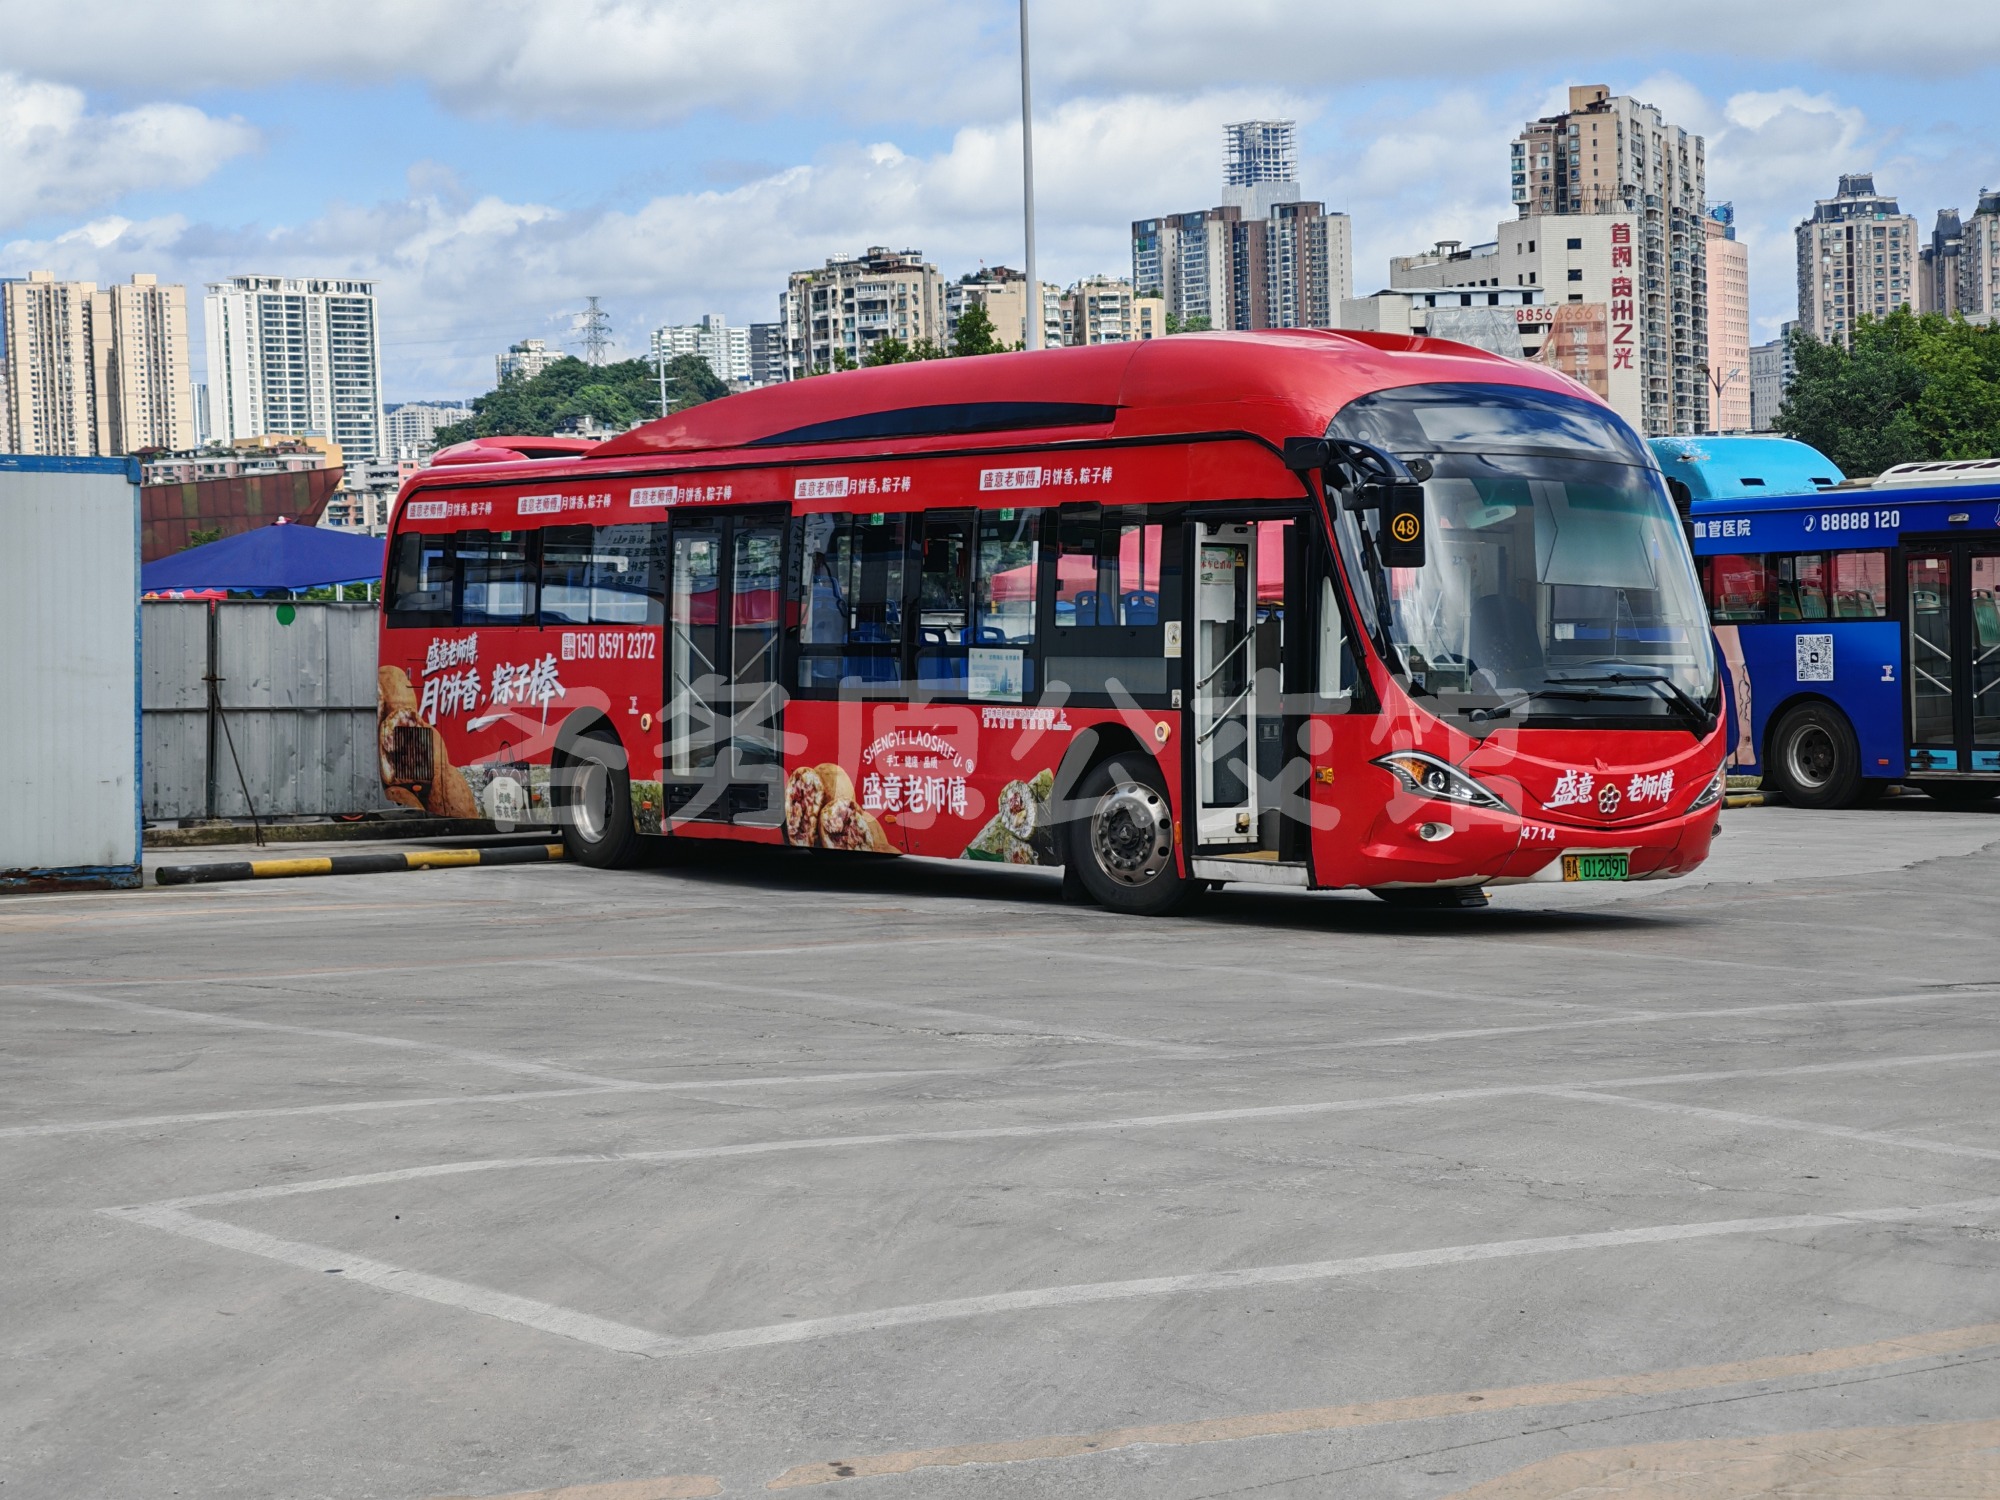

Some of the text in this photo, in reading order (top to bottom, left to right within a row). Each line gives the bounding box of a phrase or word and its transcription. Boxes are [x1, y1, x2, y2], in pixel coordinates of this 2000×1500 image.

[1397, 520, 1415, 535] 48
[1694, 518, 1751, 538] 血管医院
[1821, 510, 1900, 531] 88888 120
[576, 632, 655, 659] 150 8591 2372
[863, 729, 962, 768] SHENGYI LAOSHIFU
[862, 772, 968, 816] 盛意老师傅
[1542, 769, 1676, 811] 盛意 老师傅
[1521, 826, 1556, 842] 4714
[1583, 858, 1628, 878] 01209D
